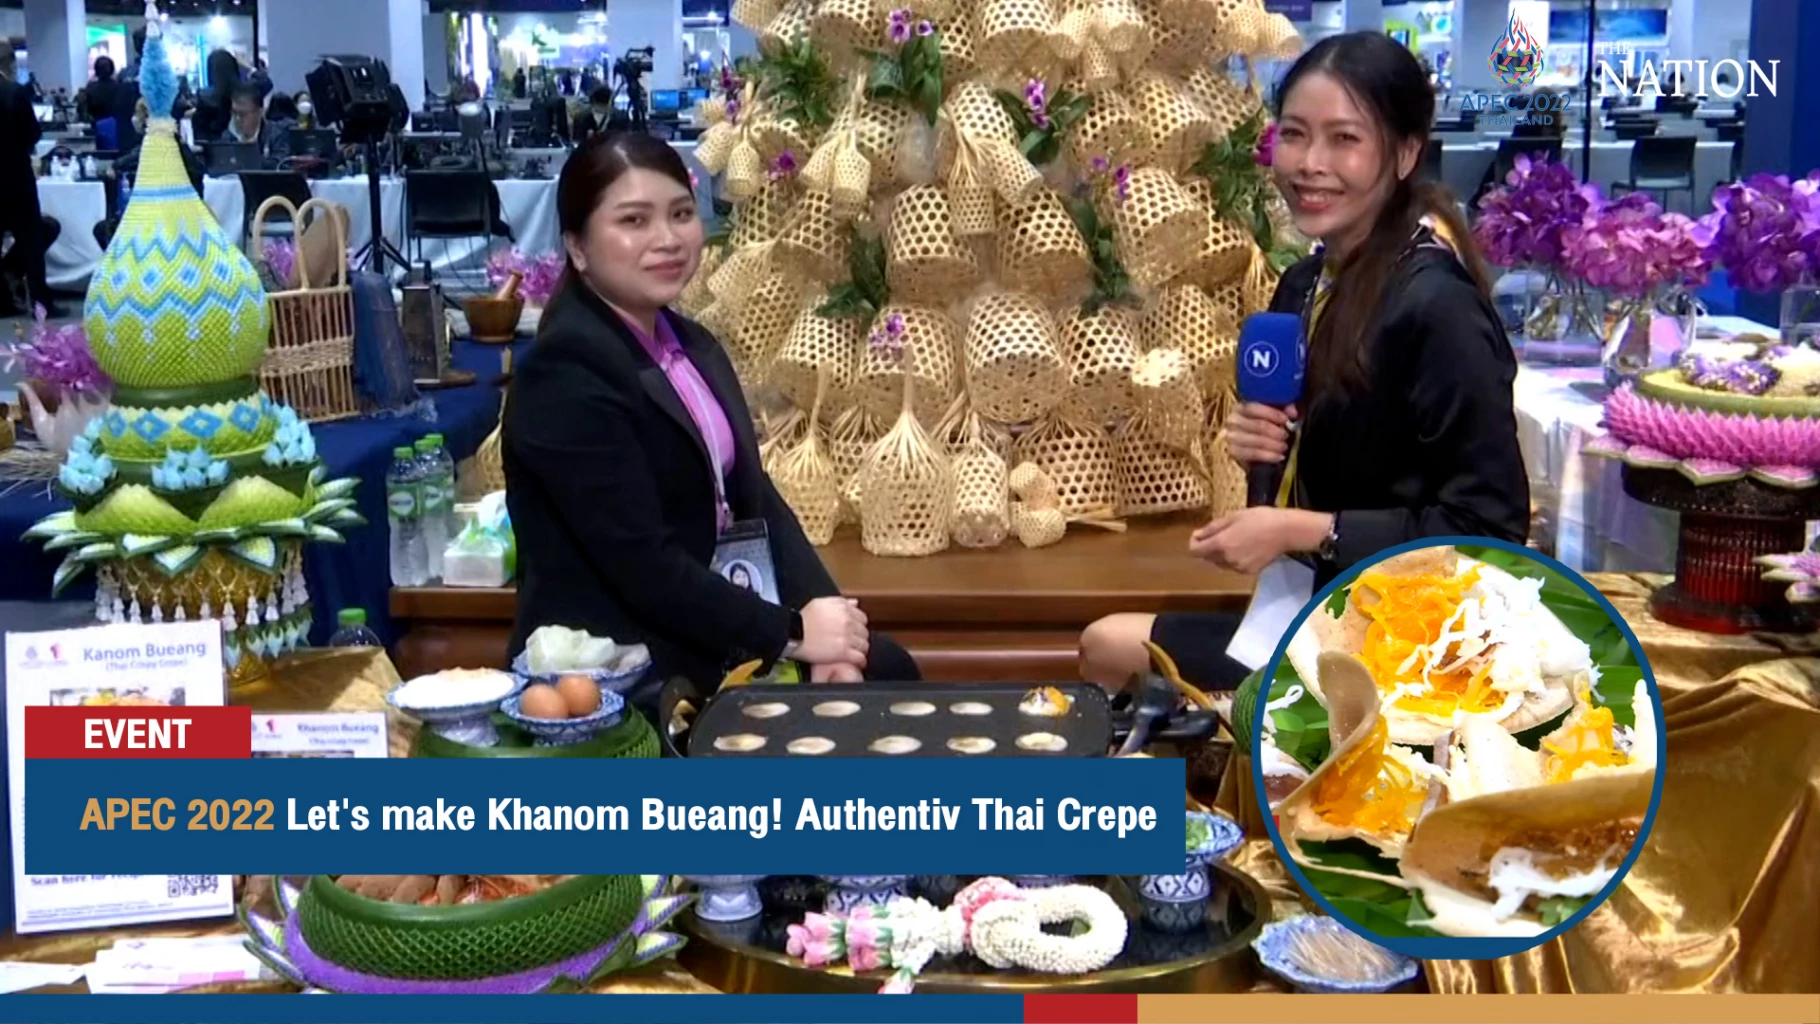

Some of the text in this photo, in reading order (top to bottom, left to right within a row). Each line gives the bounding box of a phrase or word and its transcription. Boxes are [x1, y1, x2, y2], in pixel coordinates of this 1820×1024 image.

[1252, 349, 1270, 369] N
[83, 642, 206, 661] Kanom Bueang
